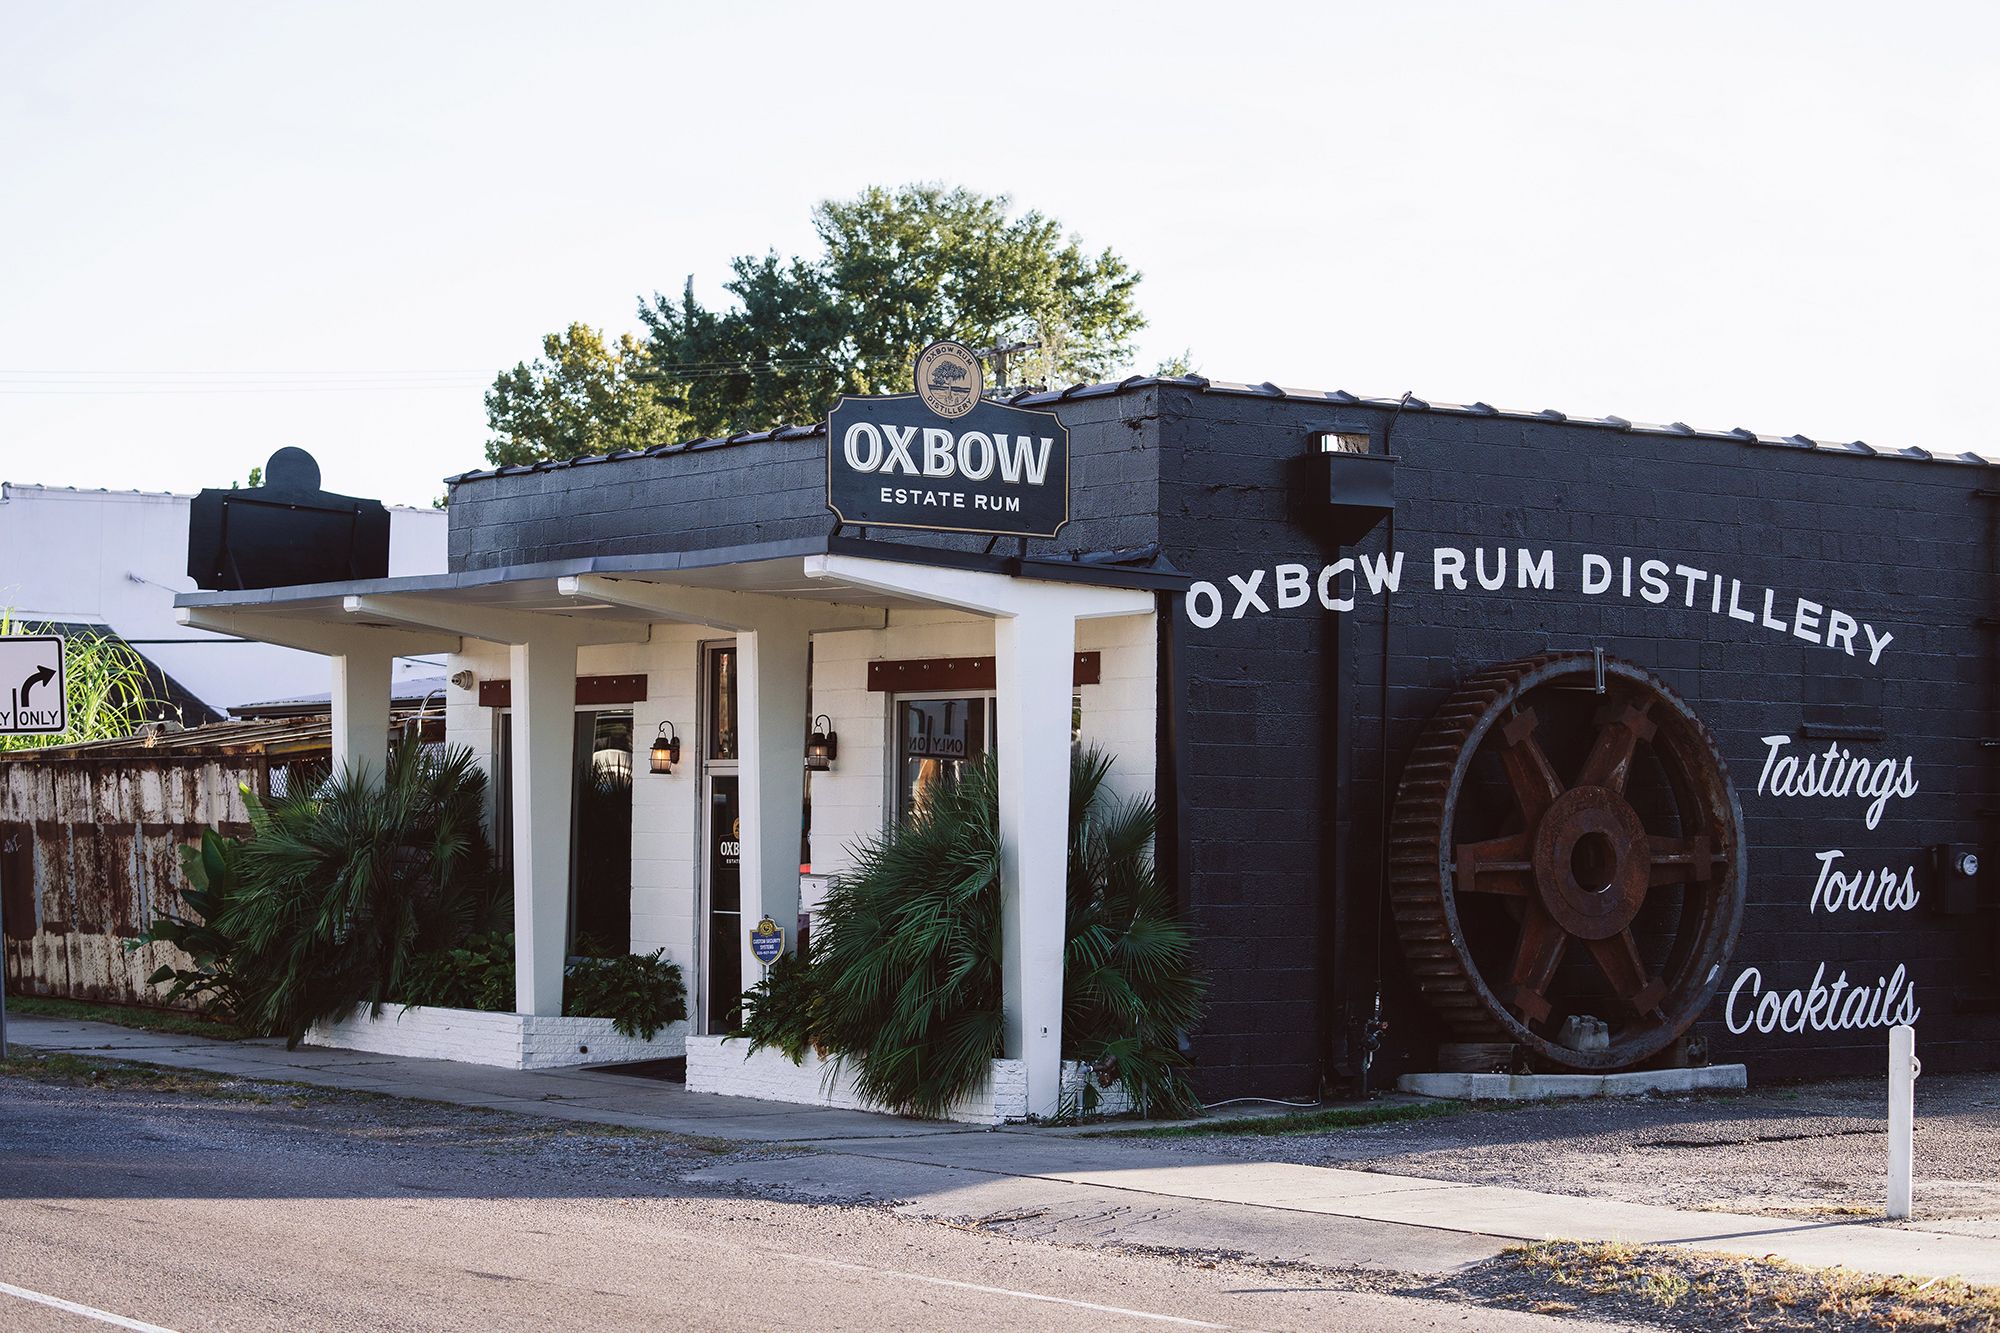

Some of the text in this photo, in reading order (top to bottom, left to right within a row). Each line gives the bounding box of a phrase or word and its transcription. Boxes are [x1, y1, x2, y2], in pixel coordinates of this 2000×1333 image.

[926, 346, 973, 366] OXBOW RUM
[927, 395, 972, 415] DISTILLERY
[843, 422, 1054, 486] OXBOW
[880, 487, 1020, 512] ESTATE RUM
[1185, 547, 1894, 666] OXBOW RUM DISTILLERY
[20, 710, 59, 726] ONLY
[1757, 734, 1919, 830] Tastings
[720, 841, 740, 856] OXB
[1810, 850, 1920, 914] Tours
[1725, 961, 1921, 1034] Cocktails
